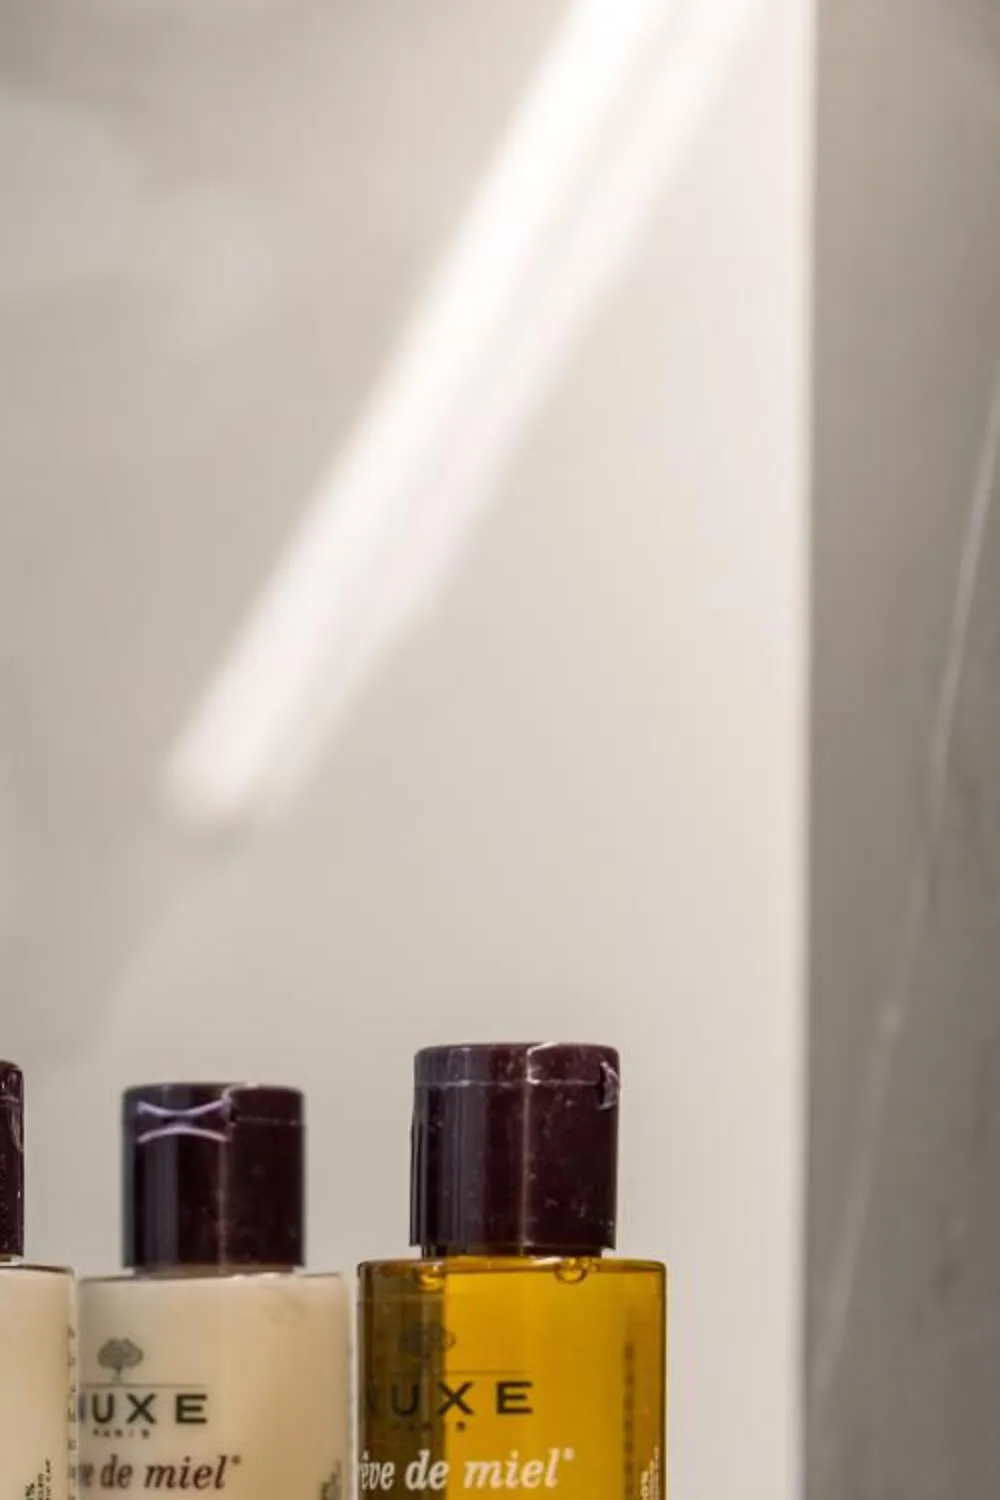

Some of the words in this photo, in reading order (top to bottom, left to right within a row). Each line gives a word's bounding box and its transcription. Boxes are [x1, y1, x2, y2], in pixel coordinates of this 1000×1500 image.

[100, 1453, 133, 1490] de
[359, 1451, 395, 1490] êve
[404, 1449, 450, 1490] de
